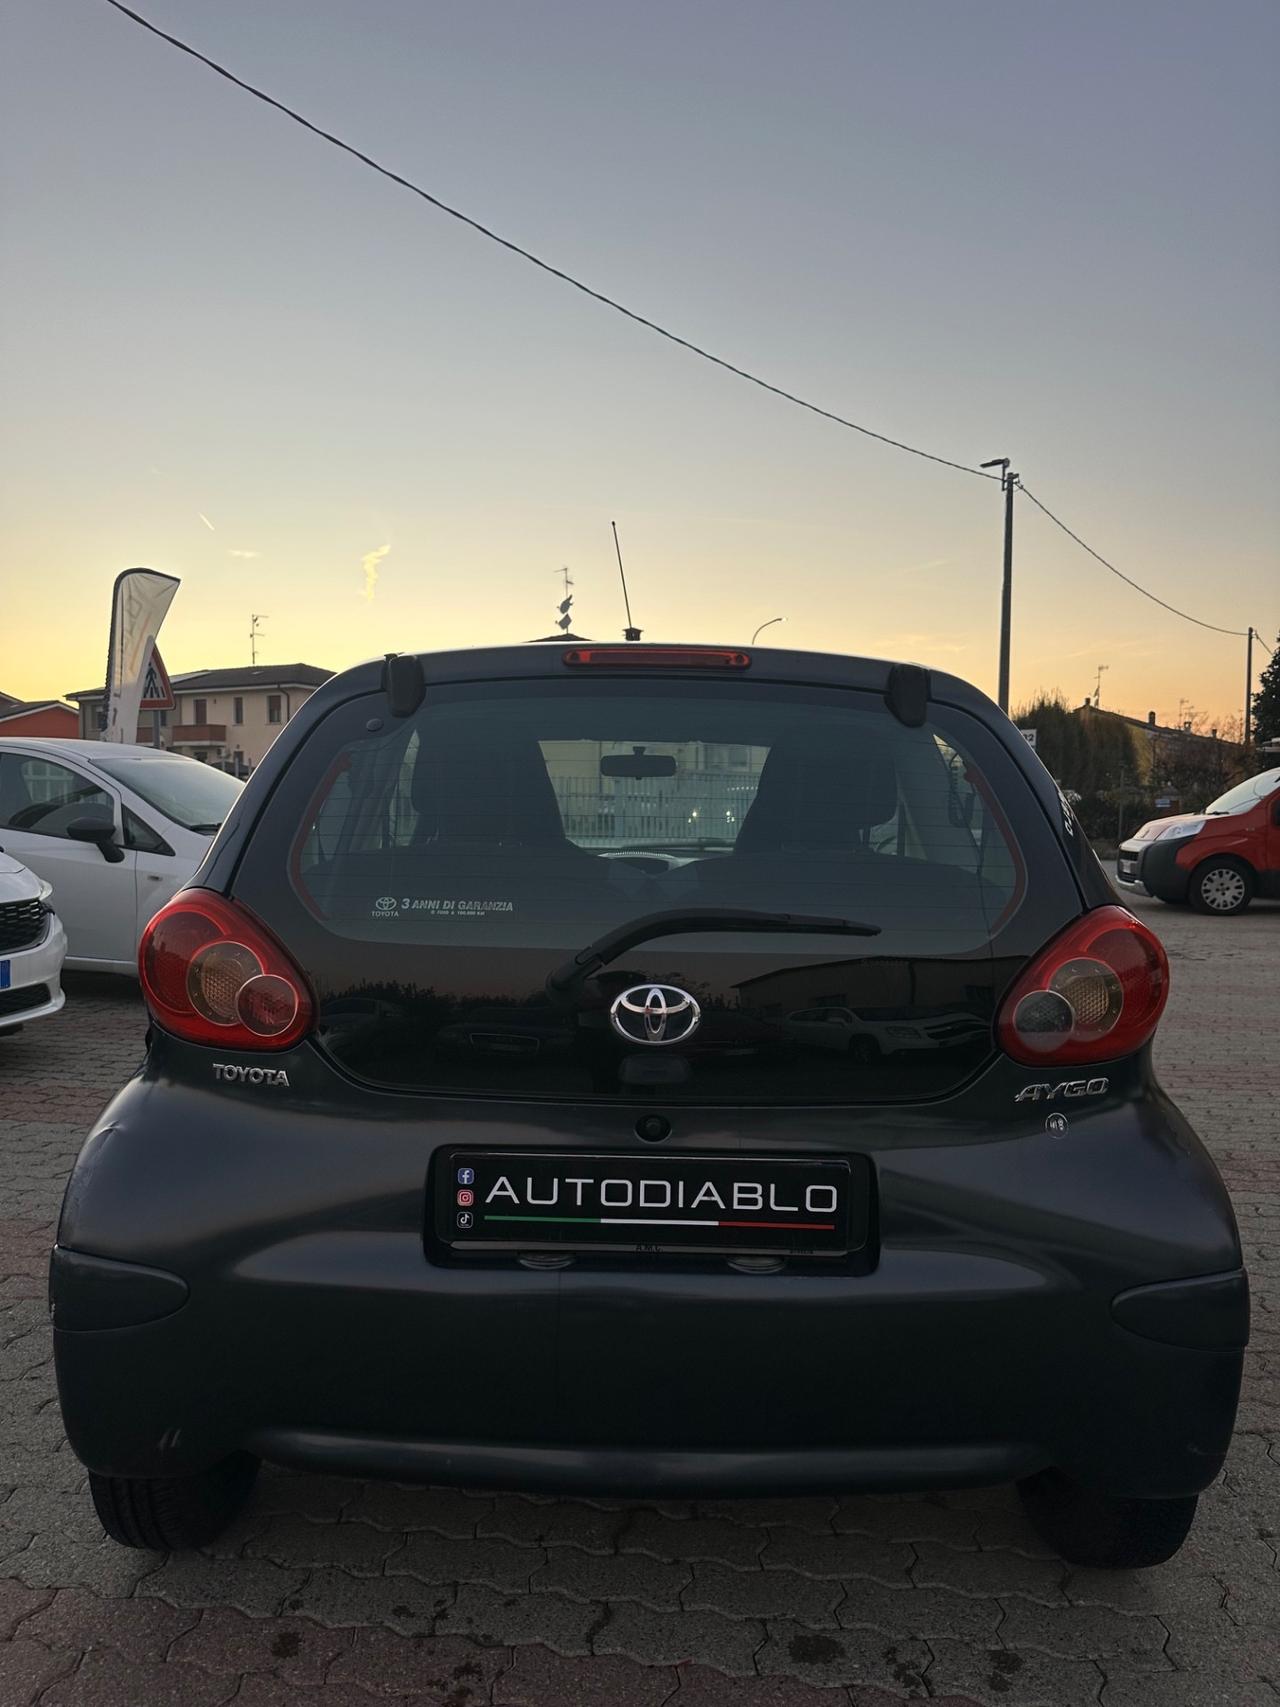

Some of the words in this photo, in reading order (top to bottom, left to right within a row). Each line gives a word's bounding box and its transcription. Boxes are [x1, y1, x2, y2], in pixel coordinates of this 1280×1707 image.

[401, 898, 410, 909] 3
[411, 900, 440, 909] ANNI
[442, 901, 455, 910] DI
[457, 901, 513, 911] GARANZIA
[212, 1063, 290, 1087] TOYOTA
[1014, 1077, 1109, 1102] AYGO
[485, 1176, 838, 1213] AUTODIABLO
